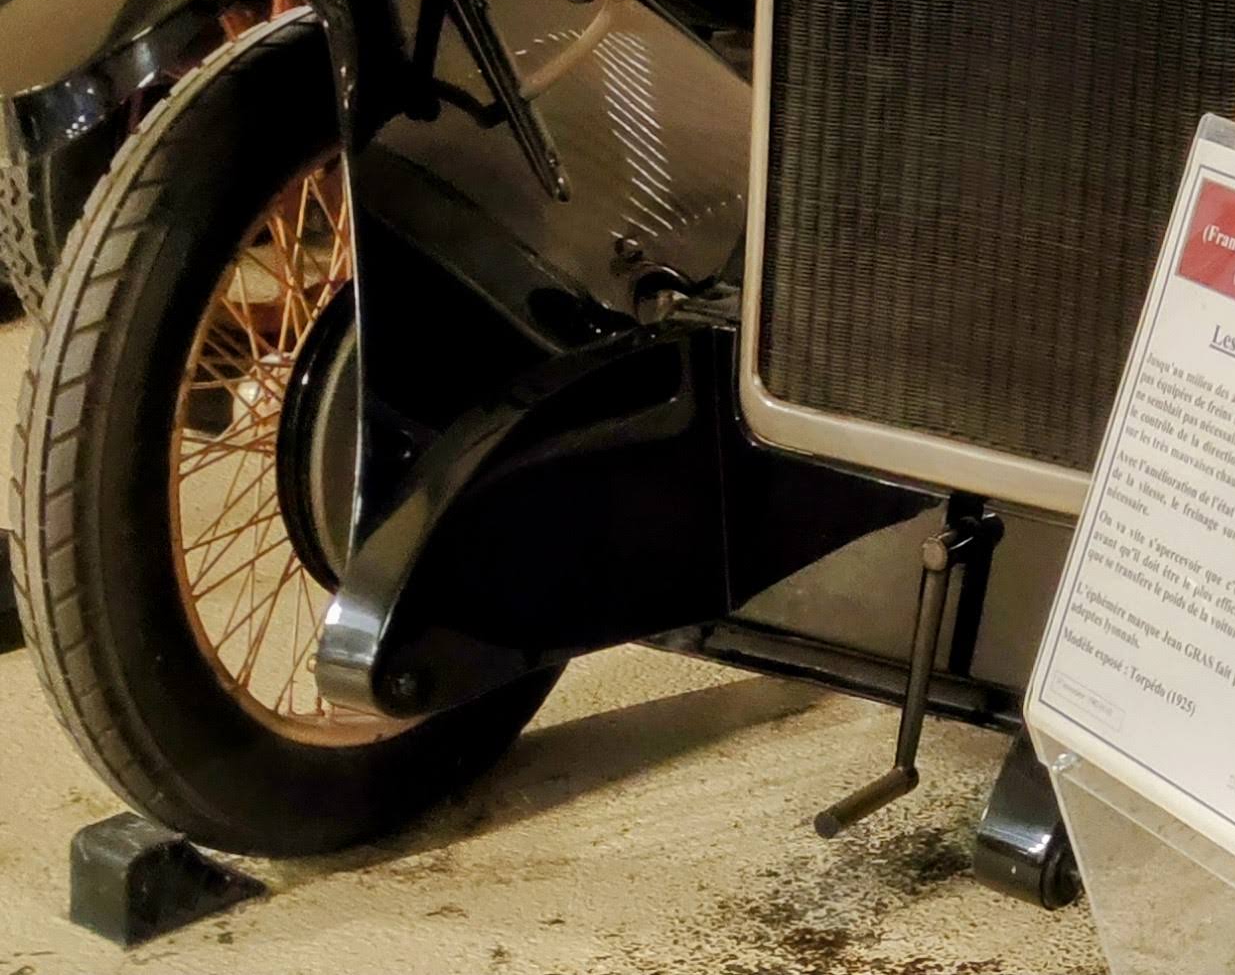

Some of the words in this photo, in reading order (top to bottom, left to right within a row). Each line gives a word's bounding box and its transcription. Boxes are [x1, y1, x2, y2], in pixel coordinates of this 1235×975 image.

[1139, 371, 1155, 386] pas
[1156, 377, 1193, 404] équipées
[1193, 395, 1206, 410] de
[1206, 400, 1232, 422] freins
[1146, 352, 1185, 380] Jusqu'au
[1185, 372, 1214, 392] milieu
[1214, 384, 1230, 401] des
[1129, 404, 1139, 419] le
[1139, 412, 1175, 436] contrôle
[1176, 428, 1189, 443] de
[1190, 433, 1200, 448] la
[1135, 389, 1147, 402] ne
[1146, 395, 1183, 419] semblait
[1181, 412, 1199, 427] pas
[1124, 424, 1140, 439] sur
[1139, 429, 1151, 445] les
[1152, 437, 1169, 454] très
[1111, 466, 1123, 482] de
[1125, 472, 1135, 488] la
[1170, 496, 1180, 511] le
[1182, 502, 1219, 532] freinage
[1116, 449, 1139, 469] Avec
[1198, 490, 1211, 506] de
[1210, 495, 1235, 518] l'état
[1092, 530, 1118, 550] avant
[1141, 555, 1161, 574] doit
[1181, 575, 1191, 591] le
[1098, 509, 1113, 527] On
[1116, 521, 1127, 534] va
[1129, 528, 1146, 545] vite
[1204, 569, 1223, 586] que
[1087, 548, 1105, 564] que
[1104, 557, 1115, 569] se
[1153, 581, 1163, 596] le
[1161, 589, 1187, 610] poids
[1186, 601, 1199, 617] de
[1198, 606, 1209, 623] la
[1126, 612, 1161, 639] marque
[1161, 630, 1183, 652] Jean
[1184, 643, 1214, 669] GRAS
[1214, 660, 1232, 680] fait
[1166, 689, 1196, 718] (1925)
